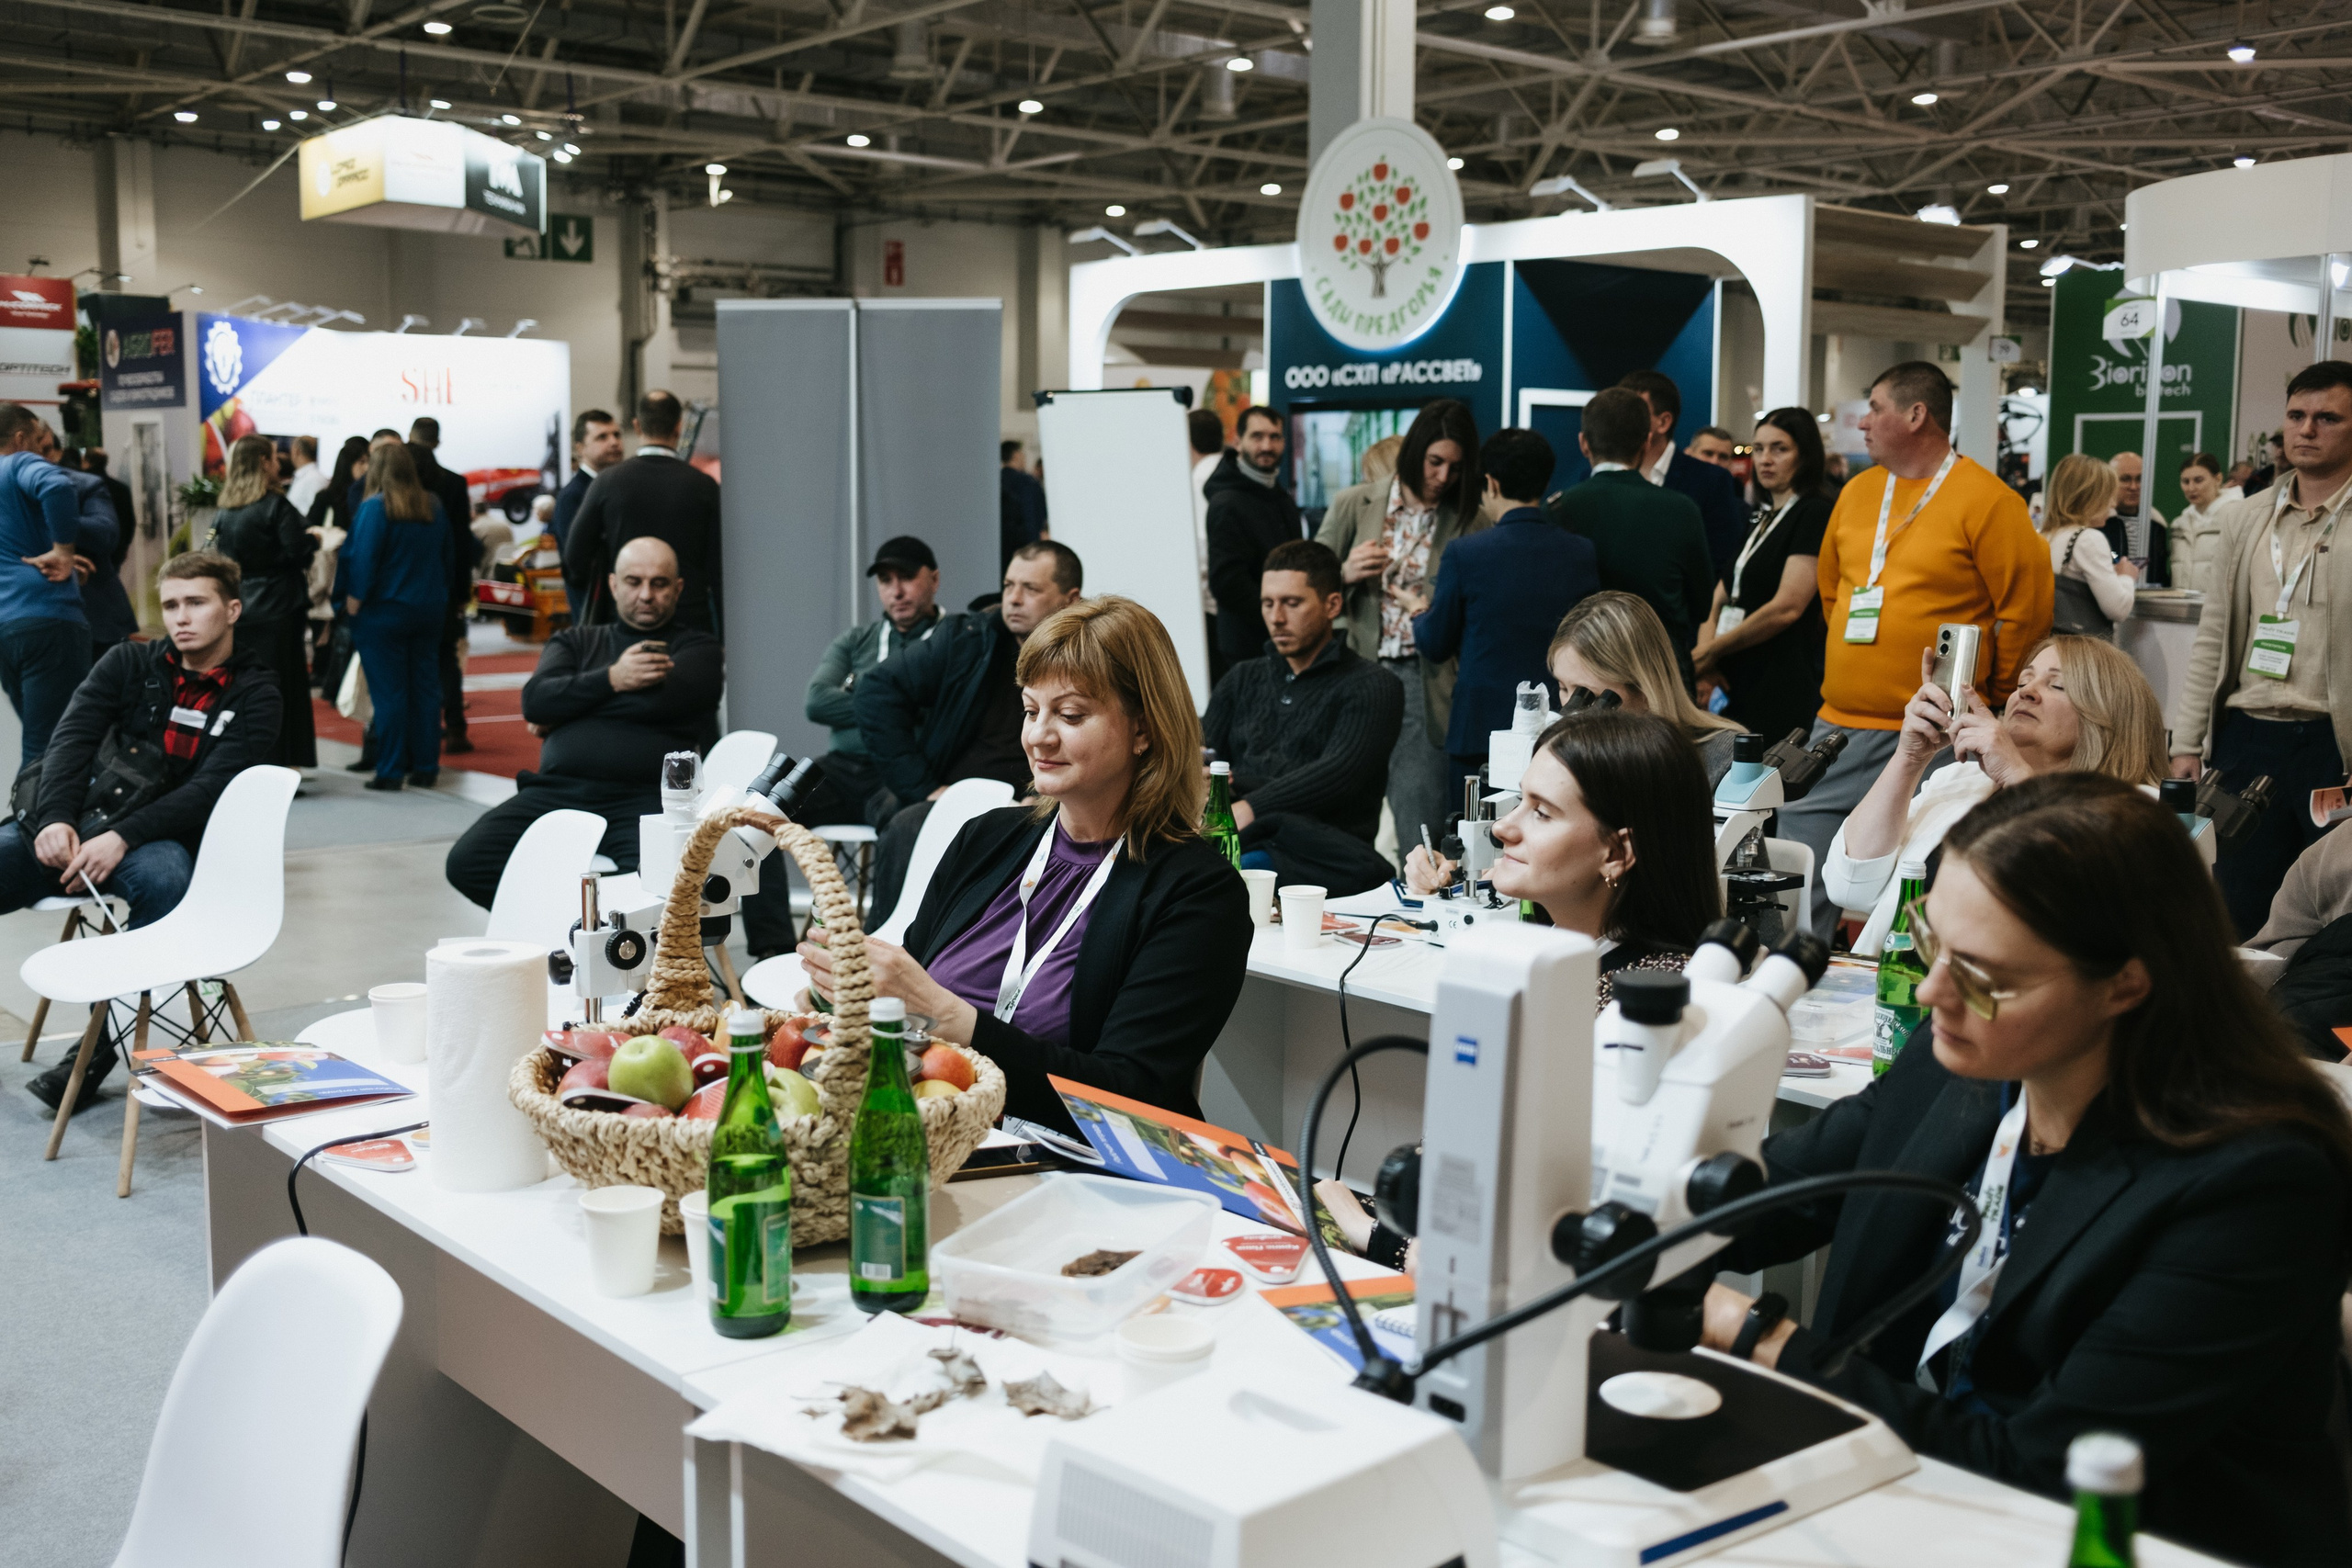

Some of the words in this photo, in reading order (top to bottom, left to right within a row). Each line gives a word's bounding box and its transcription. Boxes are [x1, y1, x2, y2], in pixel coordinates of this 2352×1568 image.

[1315, 276, 1354, 325] САДЫ
[1354, 266, 1442, 336] ПРЕДГОРЬЯ
[2120, 312, 2139, 327] 64
[1284, 366, 1330, 389] ООО
[2088, 355, 2192, 391] Biorion
[2134, 383, 2191, 398] bitech
[1448, 919, 1457, 929] CE
